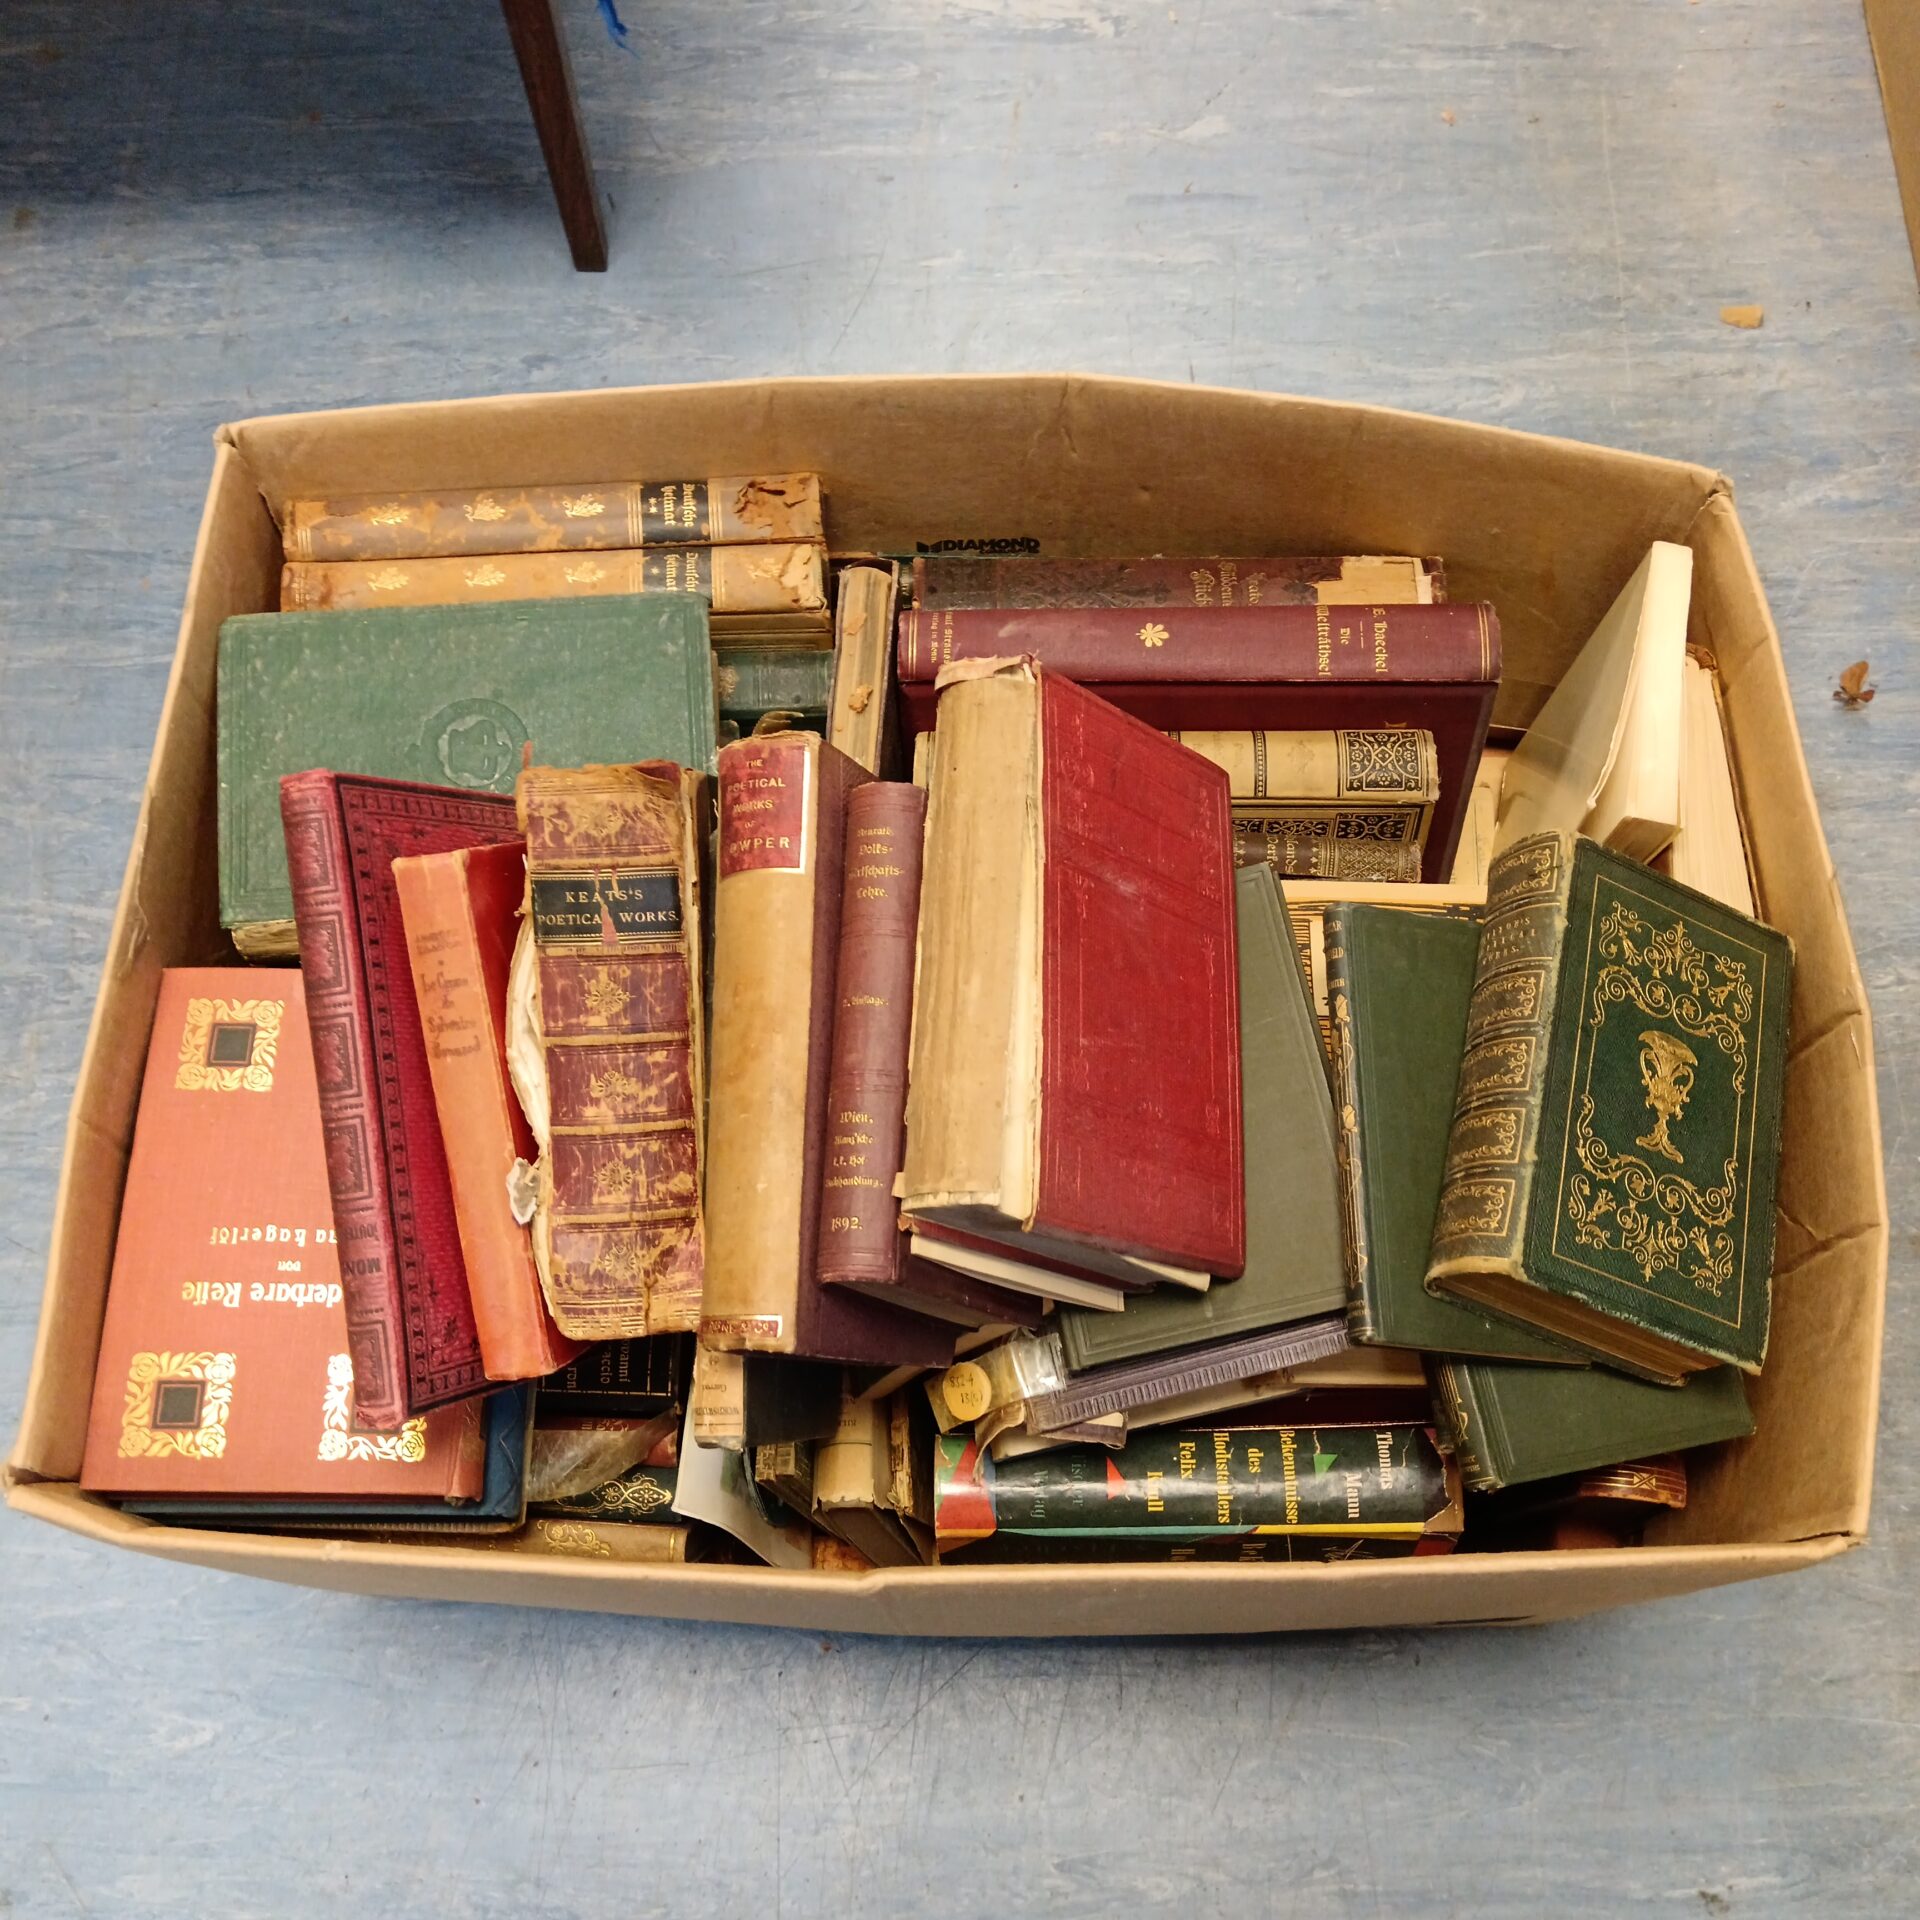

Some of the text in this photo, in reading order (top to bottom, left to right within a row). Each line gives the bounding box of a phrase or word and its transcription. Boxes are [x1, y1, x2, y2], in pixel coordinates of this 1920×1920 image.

[943, 537, 1040, 553] DIAMOND
[1340, 627, 1350, 646] Die
[745, 758, 763, 767] THE
[727, 777, 786, 795] POETICAL
[565, 888, 644, 903] KEATS'S
[537, 912, 602, 927] POETICA
[277, 1260, 302, 1272] von
[250, 1282, 343, 1308] derbare
[1179, 1441, 1197, 1480] Felix
[1248, 1447, 1264, 1474] des
[1376, 1431, 1393, 1491] Thomas
[1345, 1472, 1363, 1519] Mann
